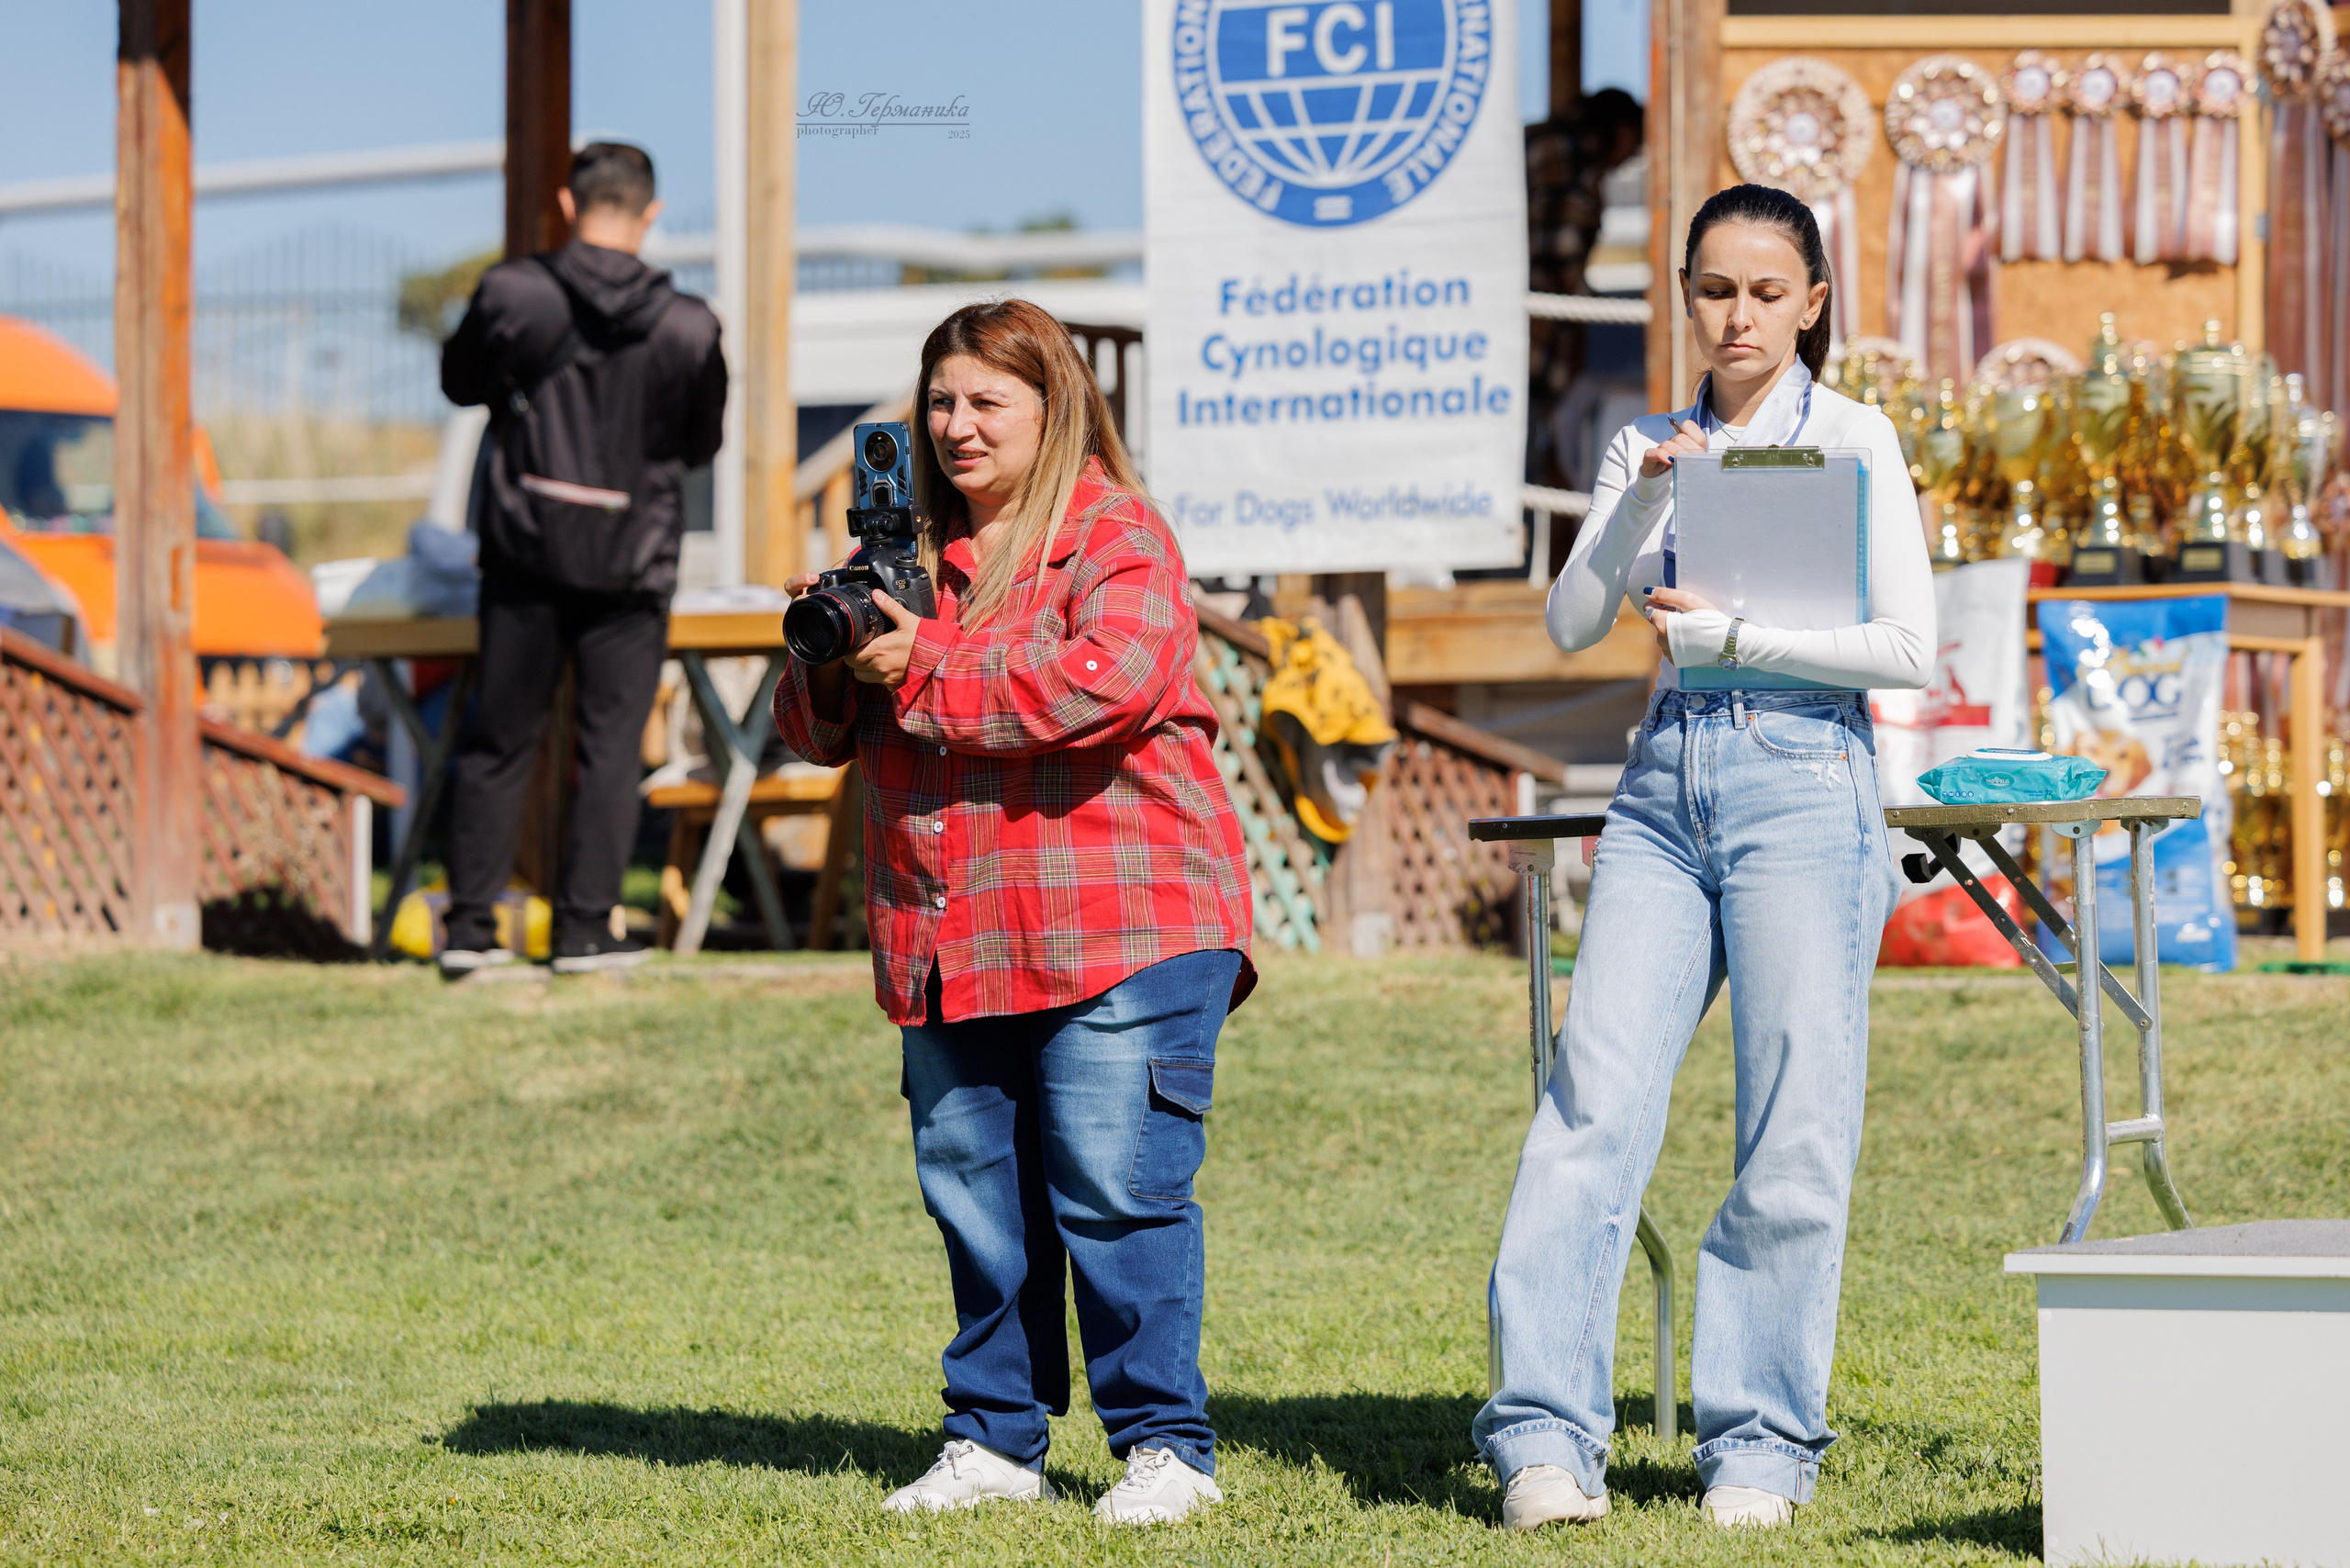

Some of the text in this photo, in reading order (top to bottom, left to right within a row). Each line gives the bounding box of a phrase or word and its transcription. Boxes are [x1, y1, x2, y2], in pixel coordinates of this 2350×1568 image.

[1266, 2, 1396, 78] FCI
[1382, 0, 1490, 205] NATIONALE
[1220, 270, 1471, 317] Fédération
[1201, 324, 1489, 380] Cynologique
[1178, 375, 1512, 426] Internationale
[1175, 483, 1494, 533] For Dogs Worldwide
